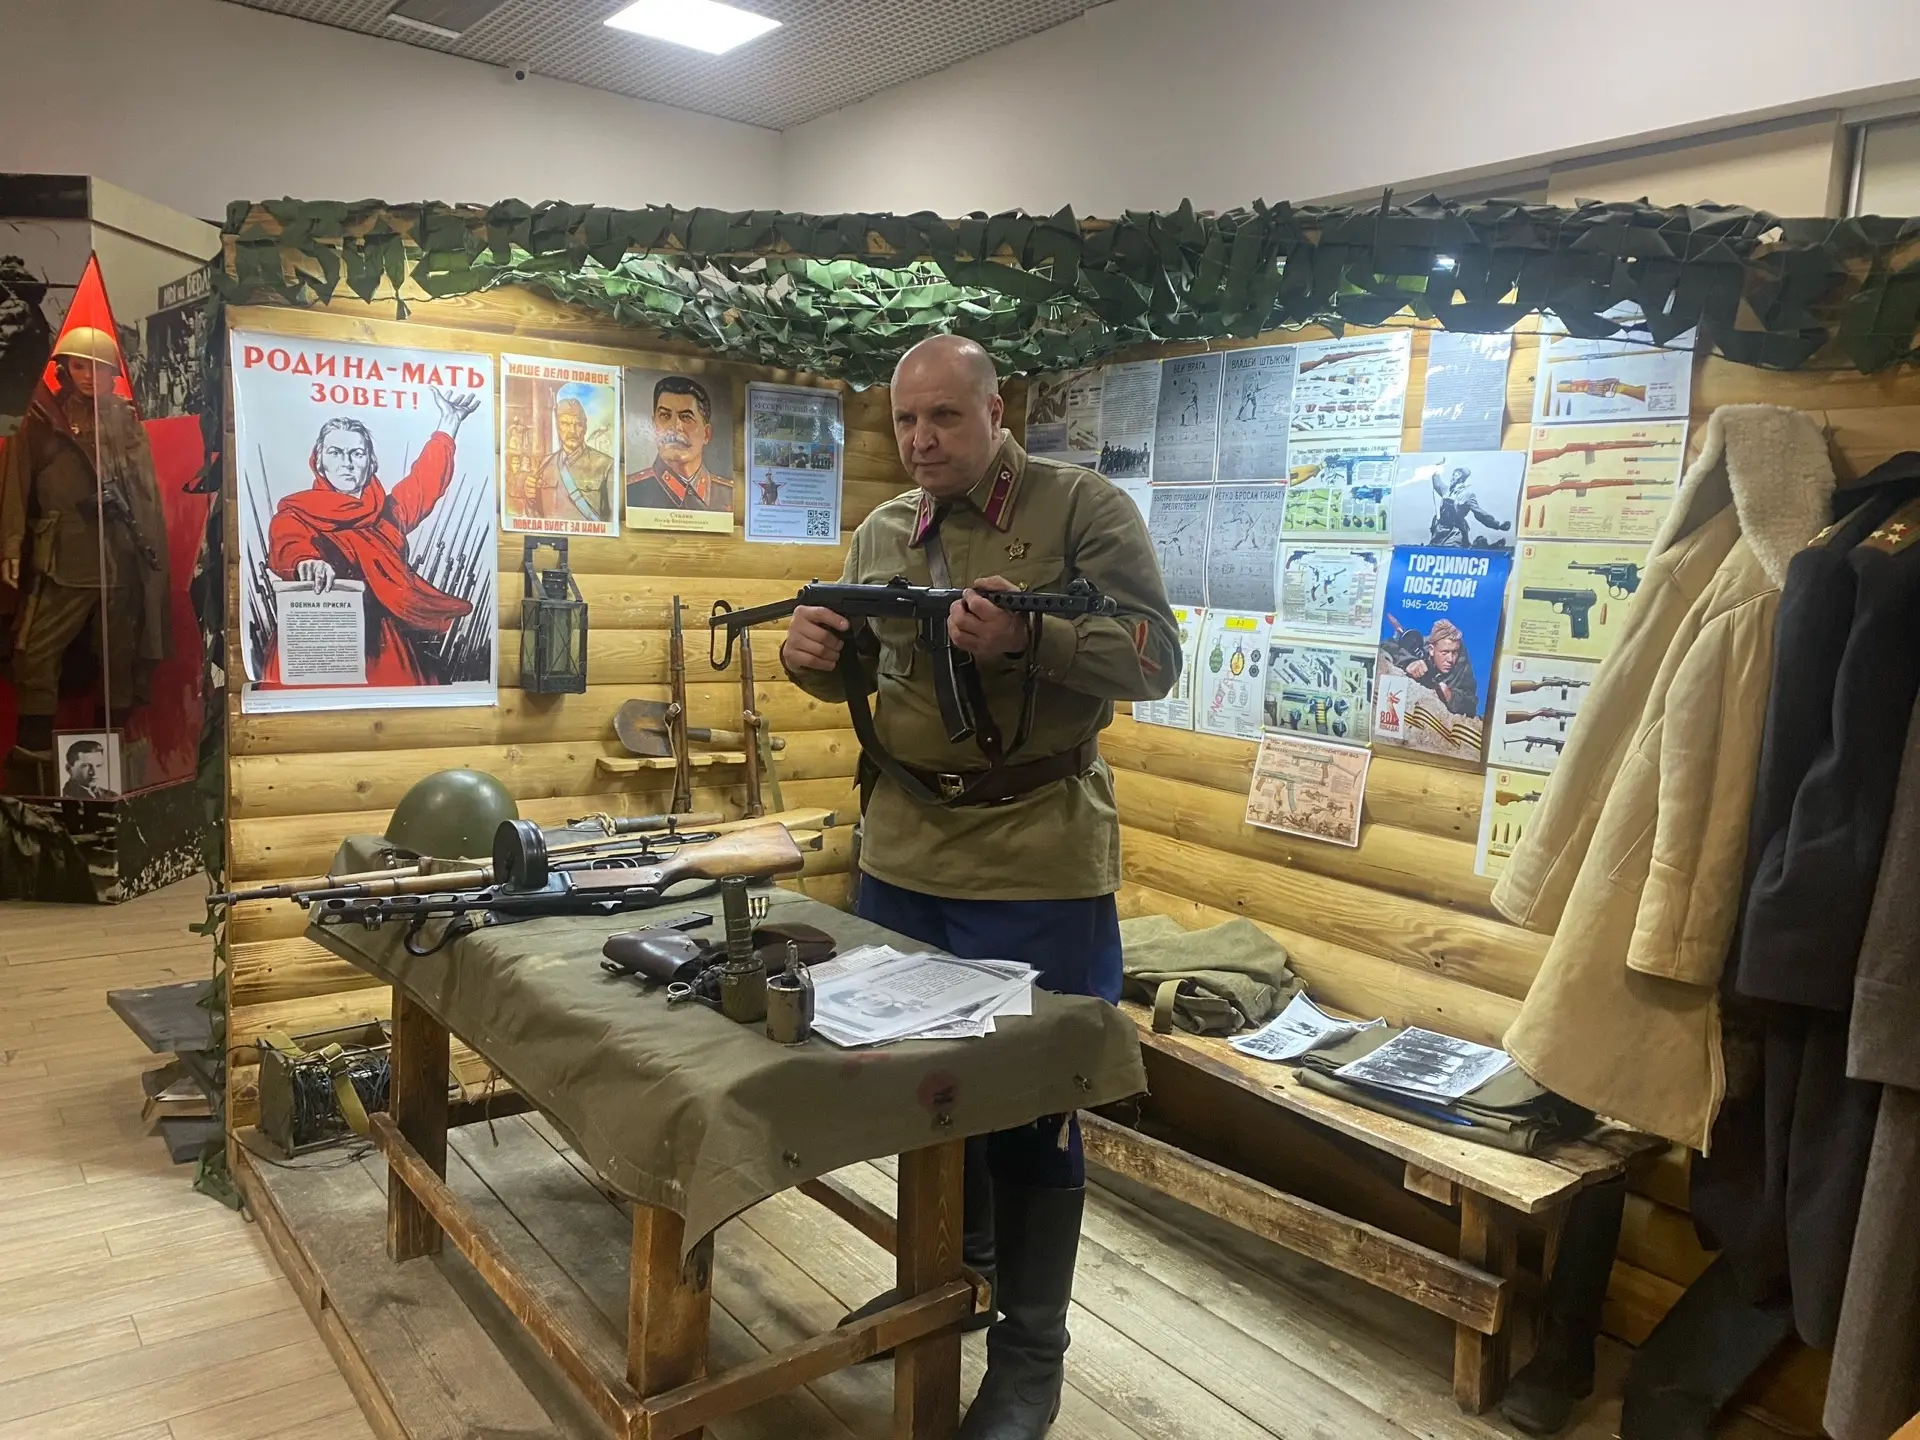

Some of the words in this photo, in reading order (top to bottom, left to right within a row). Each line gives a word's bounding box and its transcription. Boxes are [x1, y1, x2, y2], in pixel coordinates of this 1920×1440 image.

[1260, 354, 1290, 366] ШТЫКОМ
[243, 345, 485, 388] РОДИНА-МАТЬ
[1187, 361, 1206, 372] ВРАГА
[508, 363, 540, 377] НАШЕ
[543, 366, 569, 380] ДЕЛО
[572, 370, 609, 385] ПРАВОЕ
[310, 382, 419, 410] ЗОВЕТ!
[1539, 430, 1545, 438] 2
[1260, 490, 1285, 500] ГРАНАТУ
[513, 518, 542, 531] ПОБЕДА
[544, 519, 568, 532] БУДЕТ
[570, 521, 580, 533] ЗА
[582, 522, 606, 534] НАМИ
[1525, 548, 1532, 556] 3
[1408, 553, 1490, 577] ГОРДИМСЯ
[1403, 575, 1478, 599] ПОБЕДОЙ!
[290, 601, 321, 609] ВОЕННАЯ
[322, 601, 352, 609] ПРИСЯГА
[1515, 662, 1521, 670] 4
